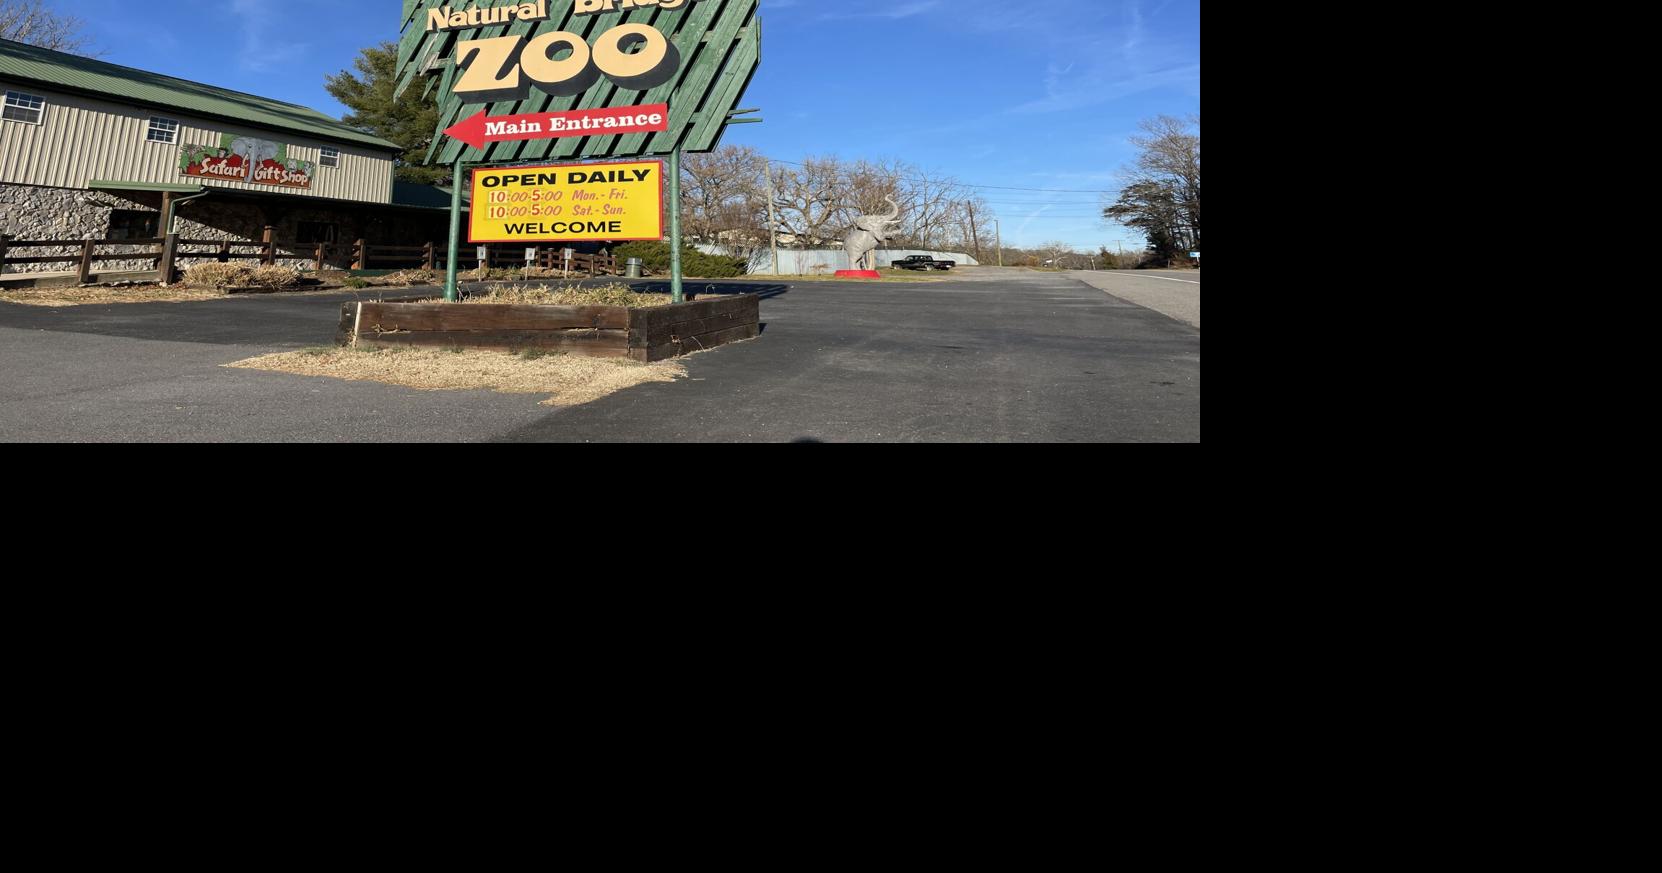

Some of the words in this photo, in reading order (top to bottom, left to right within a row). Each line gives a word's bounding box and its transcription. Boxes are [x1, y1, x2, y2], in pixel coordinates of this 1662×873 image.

[426, 0, 548, 31] Natural
[452, 22, 670, 94] ZOO
[484, 120, 542, 136] Main
[549, 113, 662, 132] Entrance
[200, 157, 246, 178] Safari
[254, 163, 281, 181] Gift
[280, 169, 308, 185] Shop
[481, 173, 557, 188] OPEN
[567, 169, 651, 185] DAILY
[504, 221, 622, 235] WELCOME
